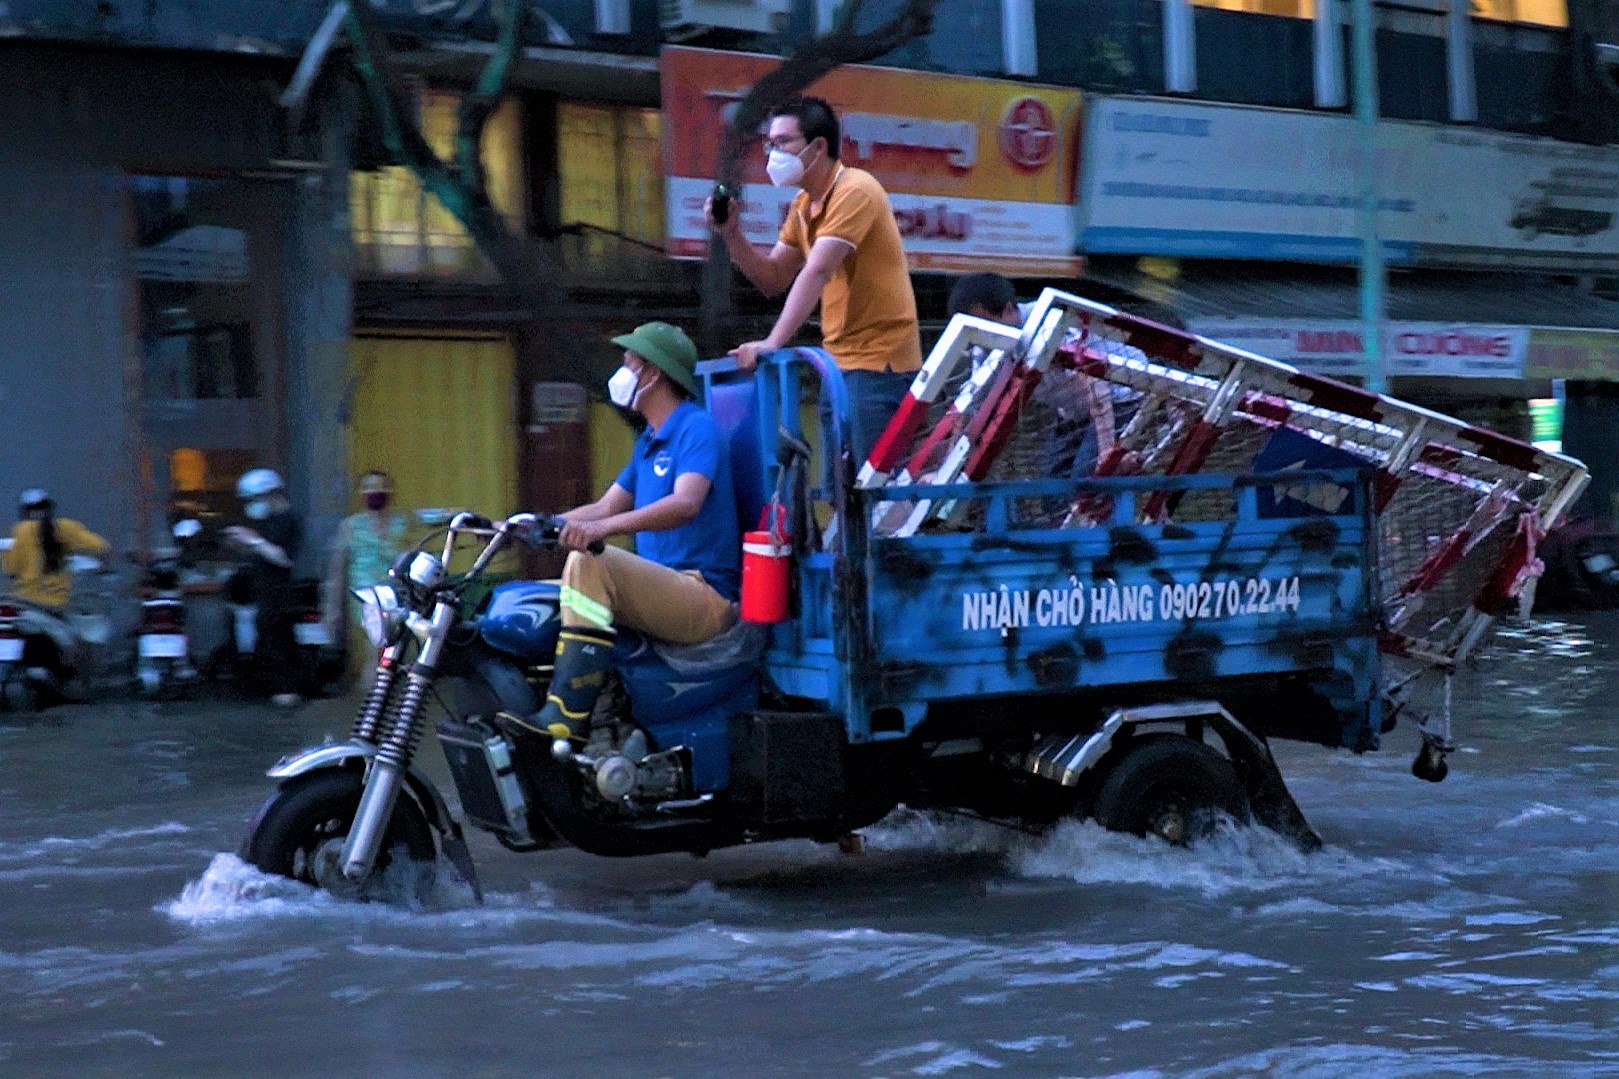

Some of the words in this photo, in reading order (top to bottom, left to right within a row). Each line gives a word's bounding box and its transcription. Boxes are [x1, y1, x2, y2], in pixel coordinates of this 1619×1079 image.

[962, 583, 1030, 637] NHẬN
[1035, 574, 1086, 627] CHỞ
[1089, 577, 1154, 623] HÀNG
[1159, 576, 1300, 621] 090270.22.44
